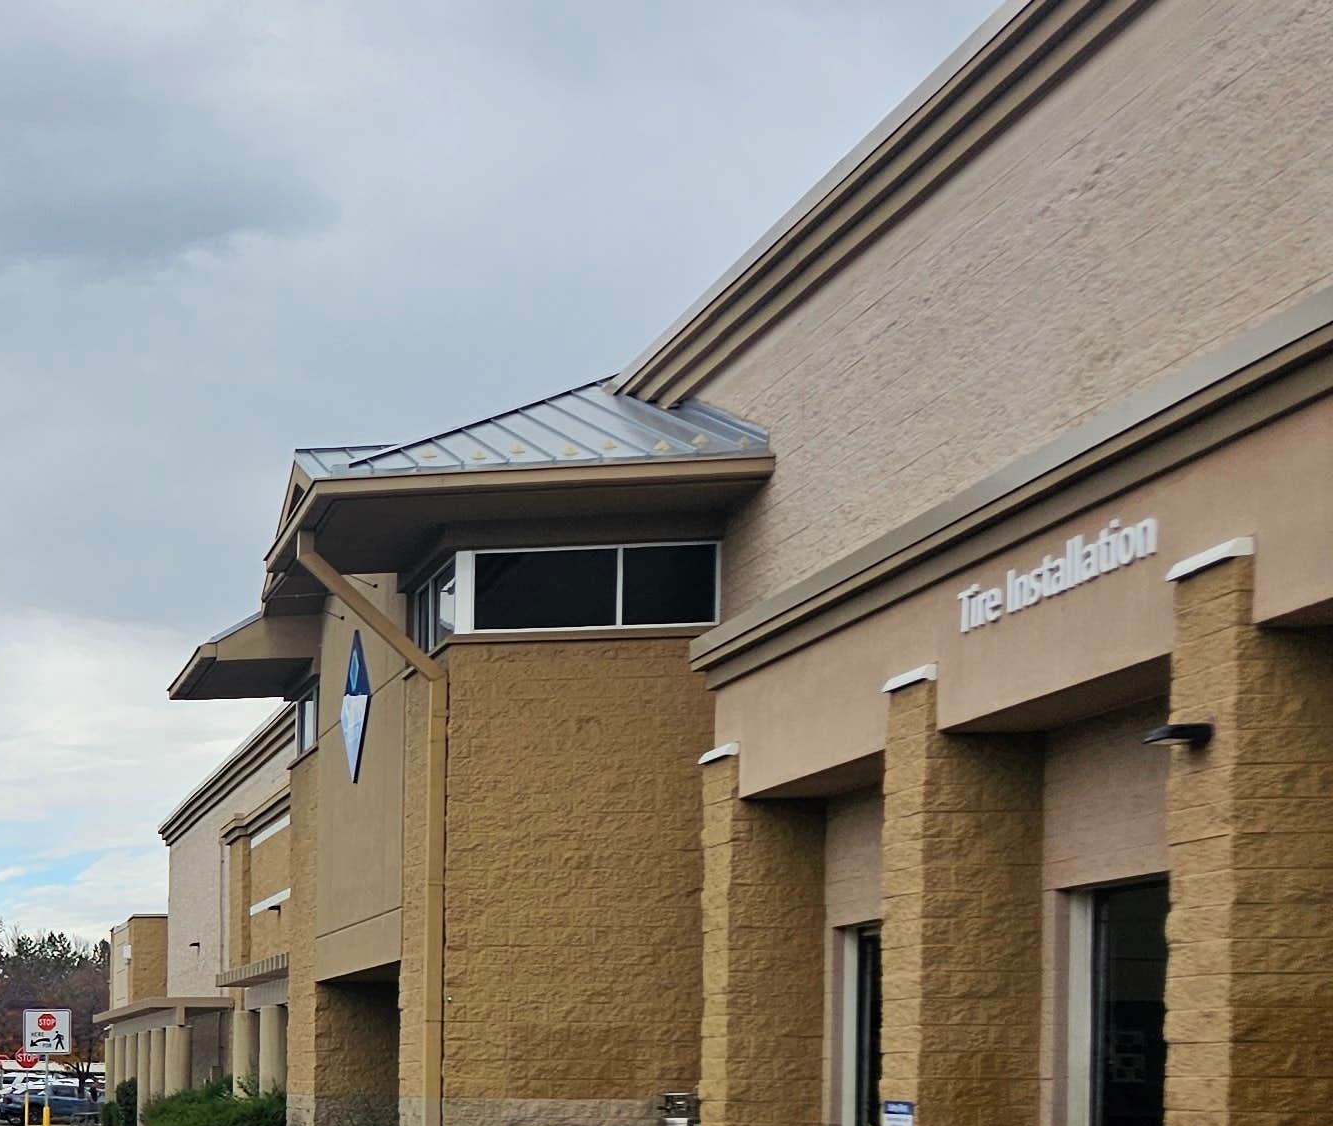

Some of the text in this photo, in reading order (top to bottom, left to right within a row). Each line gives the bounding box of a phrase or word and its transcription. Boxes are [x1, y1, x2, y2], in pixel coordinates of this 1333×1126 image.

[957, 517, 1159, 633] Tire Installation
[38, 1018, 57, 1027] STOP
[17, 1053, 39, 1063] STOP
